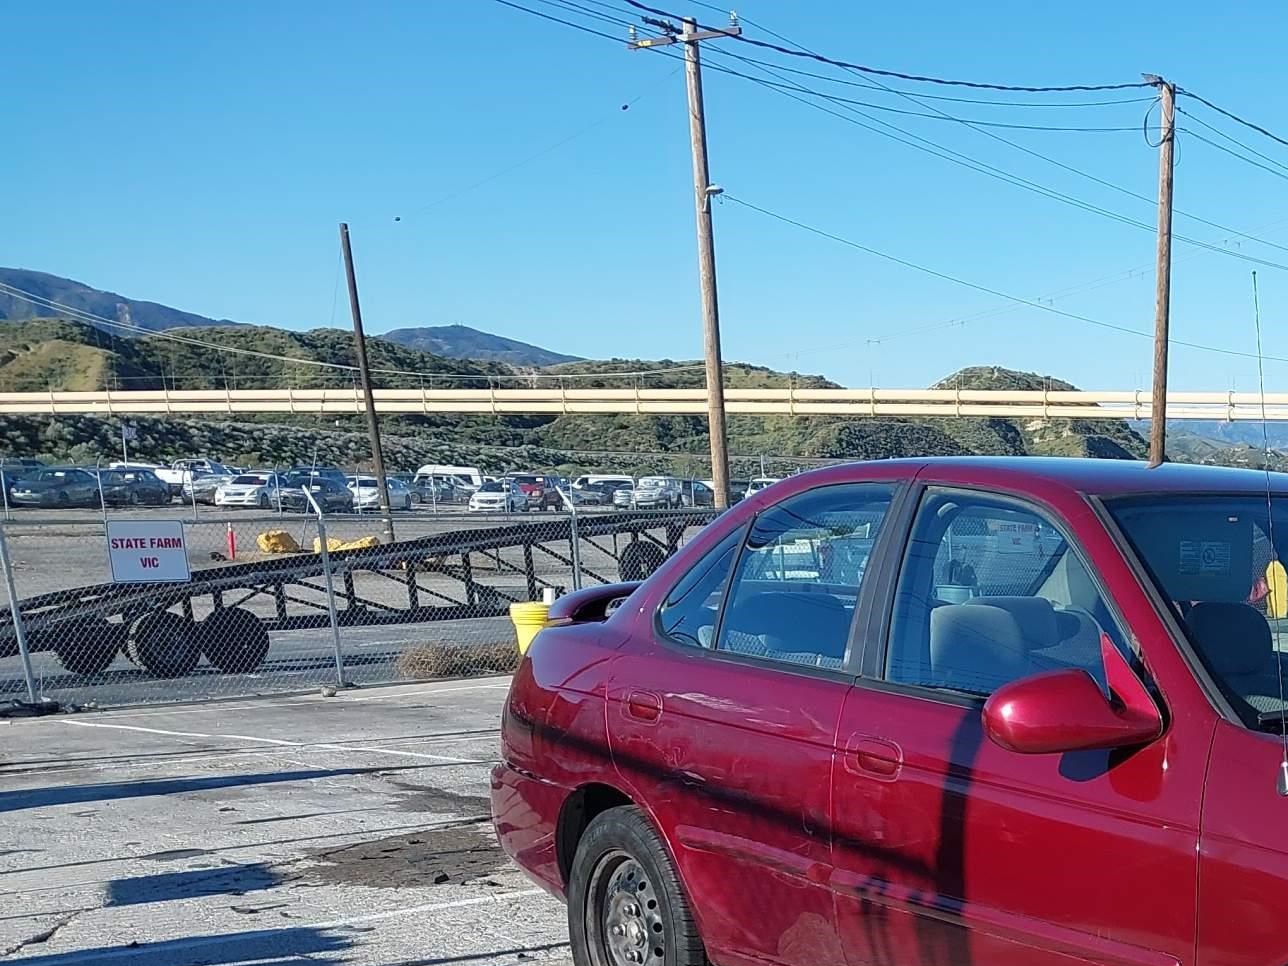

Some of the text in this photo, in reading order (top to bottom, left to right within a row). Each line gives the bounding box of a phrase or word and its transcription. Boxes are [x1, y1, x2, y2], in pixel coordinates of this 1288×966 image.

[111, 538, 182, 549] STATE FARM
[140, 557, 160, 568] VIC
